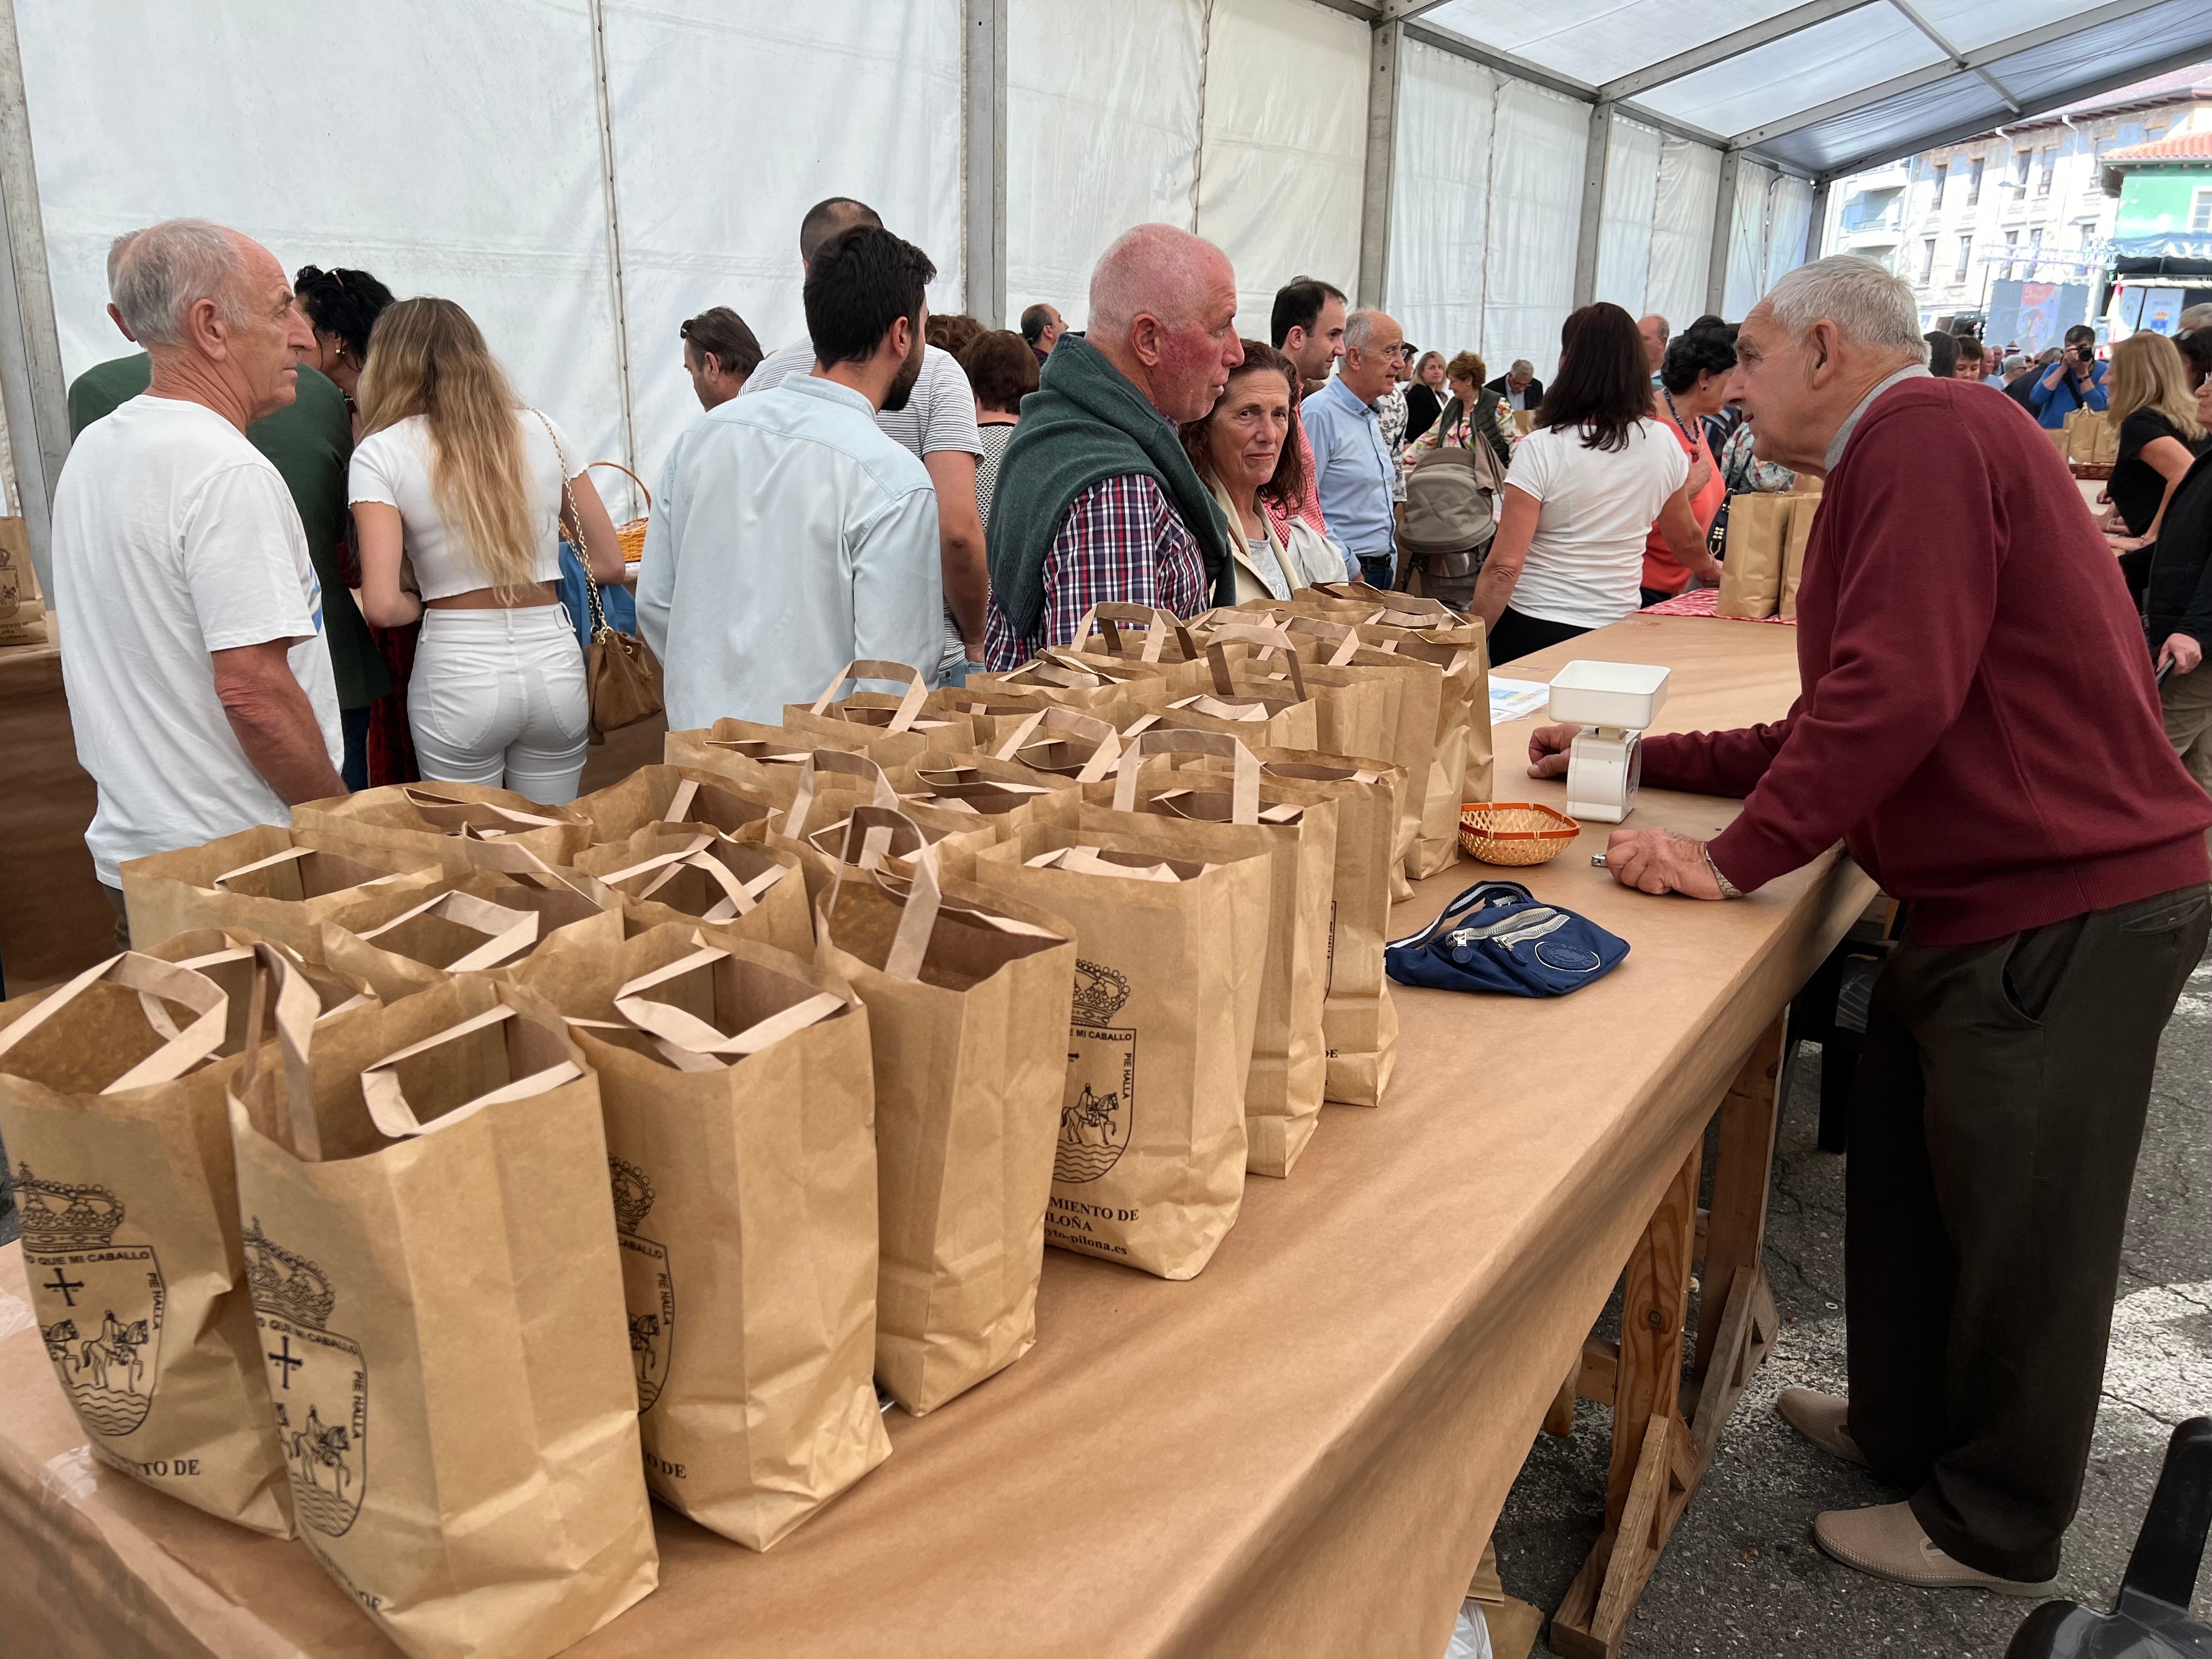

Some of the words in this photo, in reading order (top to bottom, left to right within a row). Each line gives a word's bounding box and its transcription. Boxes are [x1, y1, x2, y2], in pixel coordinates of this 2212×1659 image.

[1076, 1029, 1086, 1038] MI
[1088, 1031, 1132, 1041] CABALLO
[1124, 1052, 1132, 1068] PIE
[1122, 1069, 1131, 1100] HALLA
[1049, 1195, 1114, 1220] MIENTO
[1117, 1209, 1139, 1222] DE
[87, 1251, 150, 1263] CABALLO
[146, 1272, 161, 1289] PIE
[657, 1272, 669, 1289] PIE
[151, 1290, 164, 1330] HALLA
[661, 1291, 673, 1325] HALLA
[352, 1370, 365, 1392] PIE
[352, 1395, 365, 1439] HALLA
[173, 1459, 201, 1476] DE
[661, 1461, 687, 1479] DE
